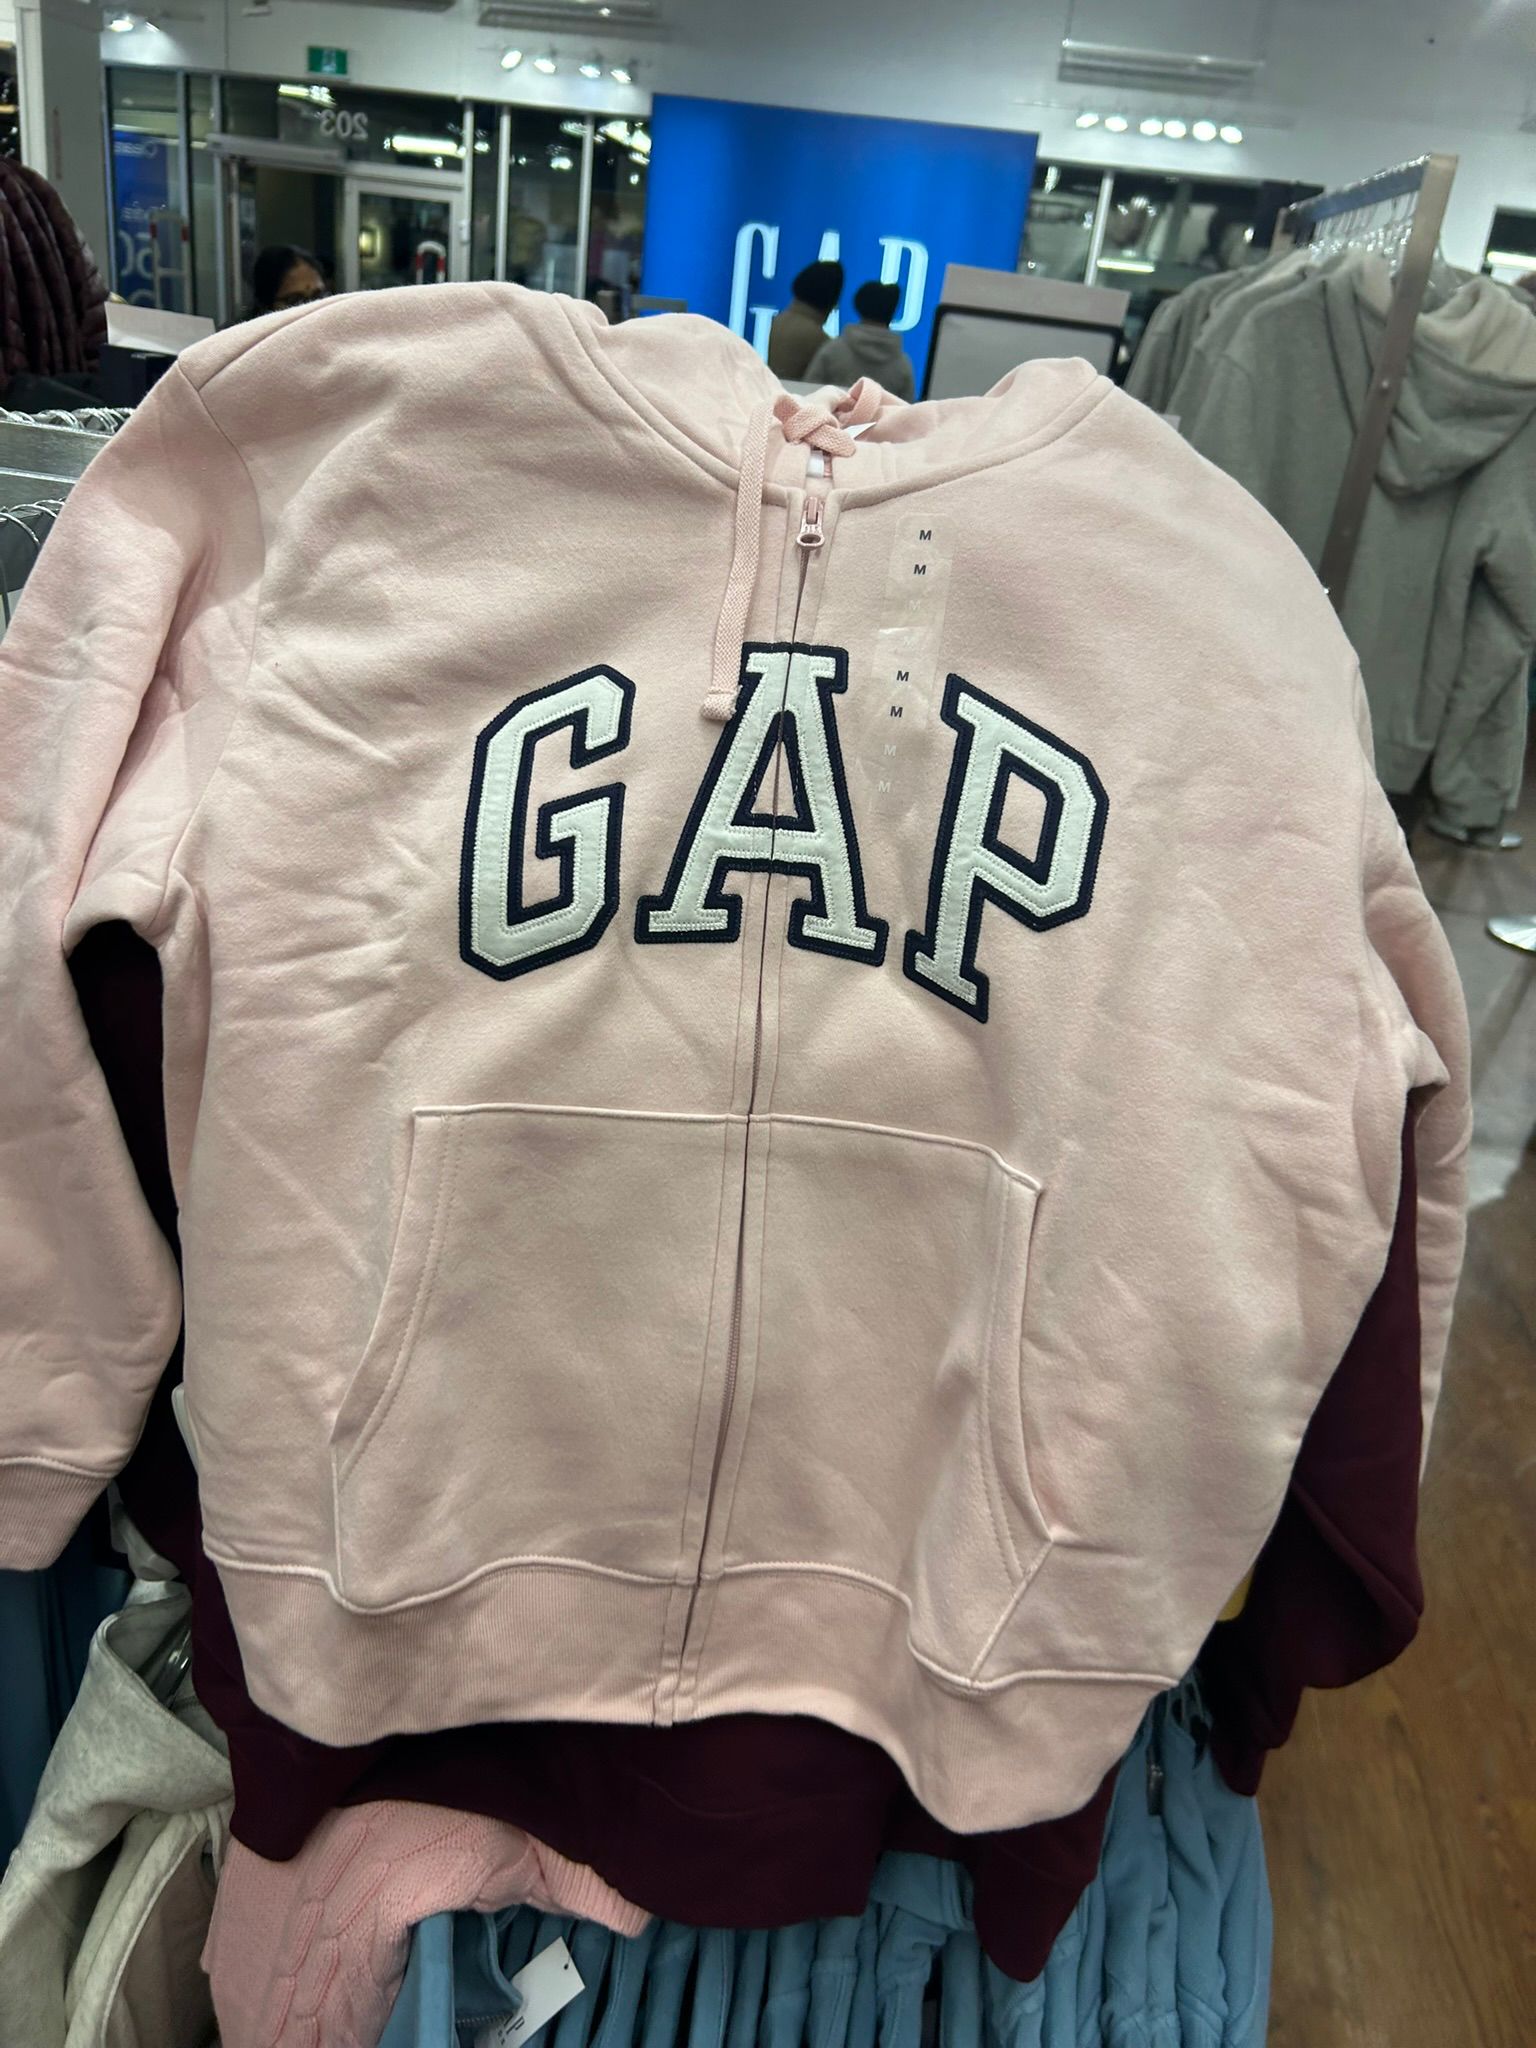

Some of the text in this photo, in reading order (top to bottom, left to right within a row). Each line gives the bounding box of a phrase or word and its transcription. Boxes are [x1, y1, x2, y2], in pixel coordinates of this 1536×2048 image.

[919, 529, 932, 541] M
[913, 564, 927, 575] M
[896, 670, 910, 682] M
[890, 705, 903, 718] M
[884, 744, 897, 756] M
[878, 780, 891, 793] M
[460, 642, 1109, 1023] GAP
